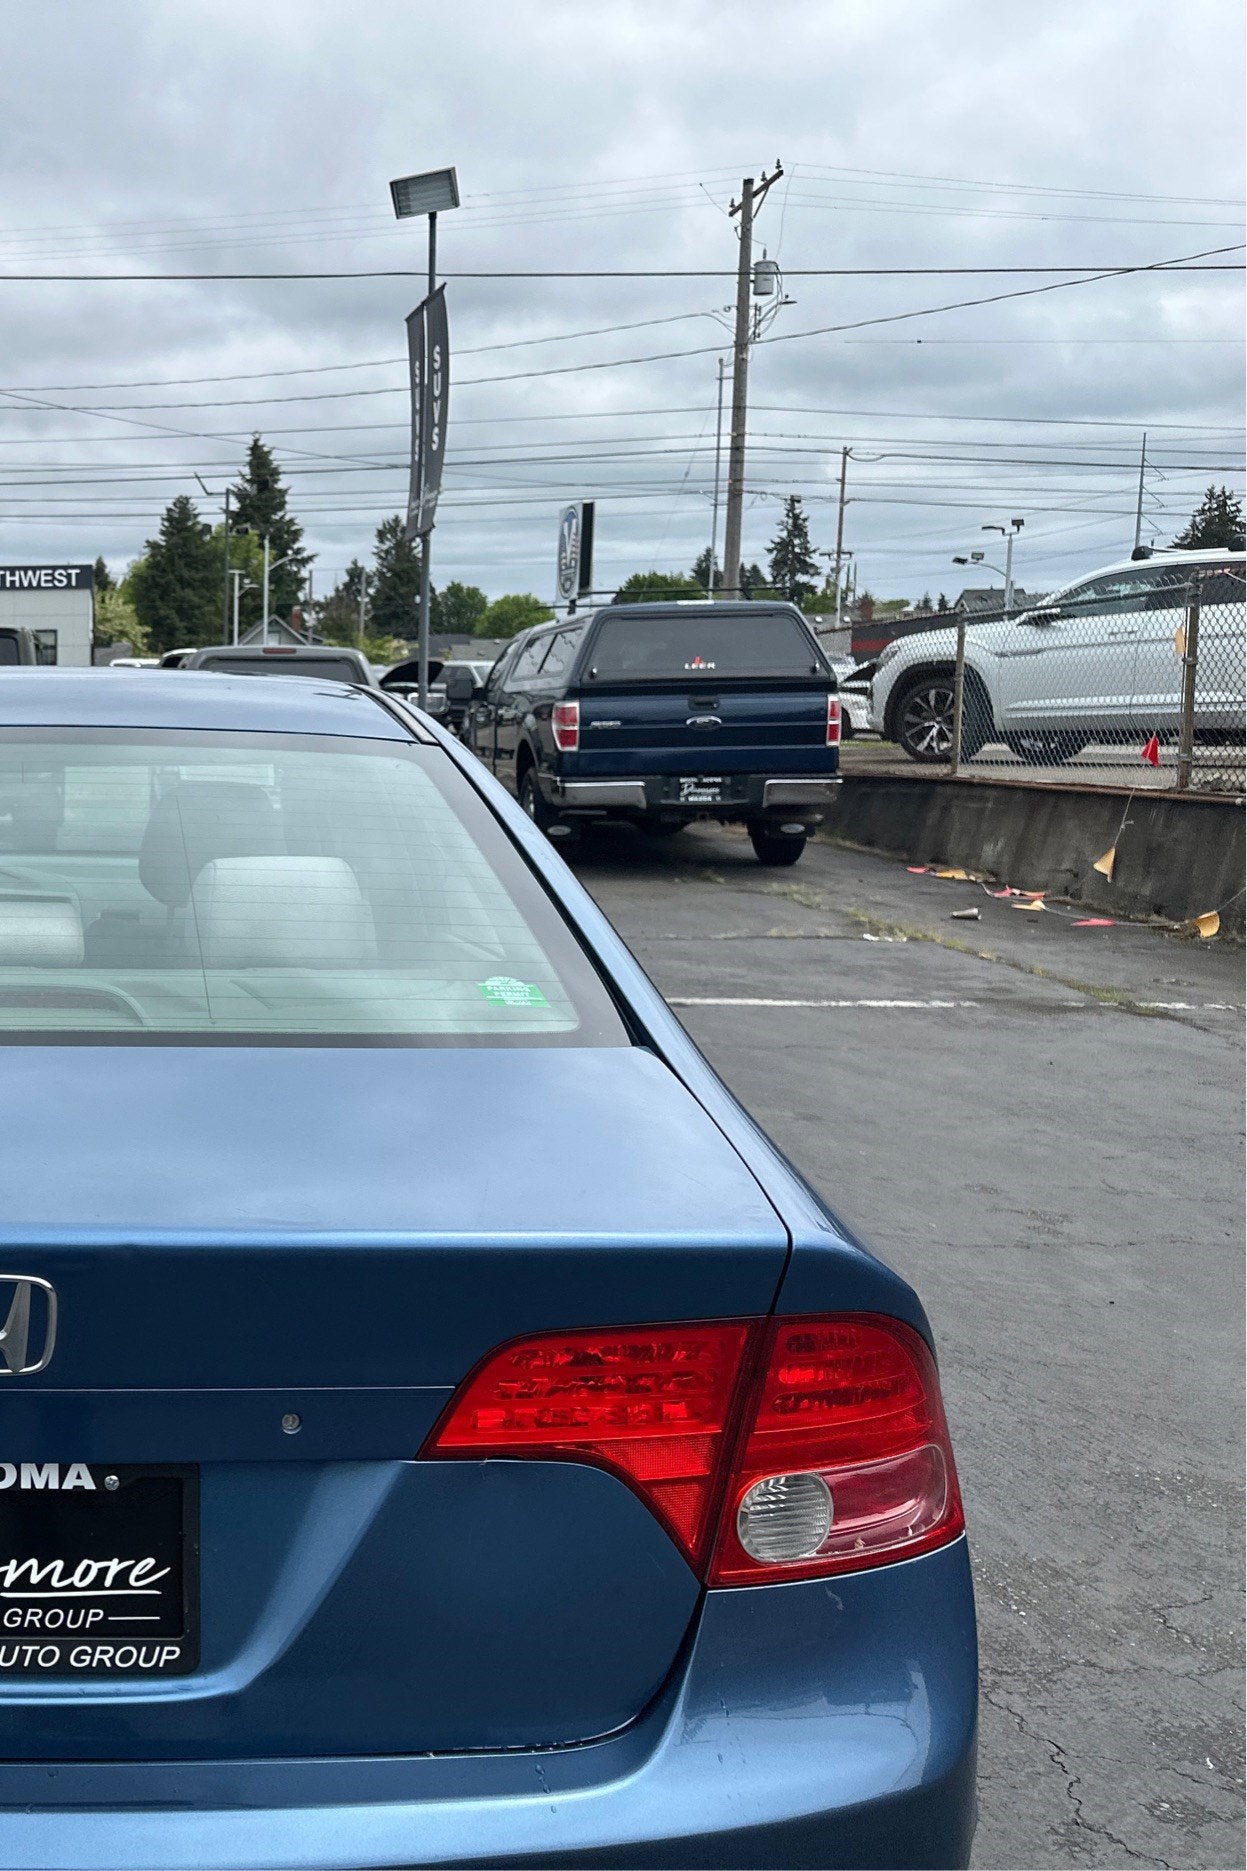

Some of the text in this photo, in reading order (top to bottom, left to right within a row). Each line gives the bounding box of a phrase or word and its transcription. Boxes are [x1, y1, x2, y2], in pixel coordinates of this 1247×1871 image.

[432, 344, 441, 451] SUVS
[3, 1607, 105, 1629] GROUP
[69, 1645, 181, 1668] GROUP
